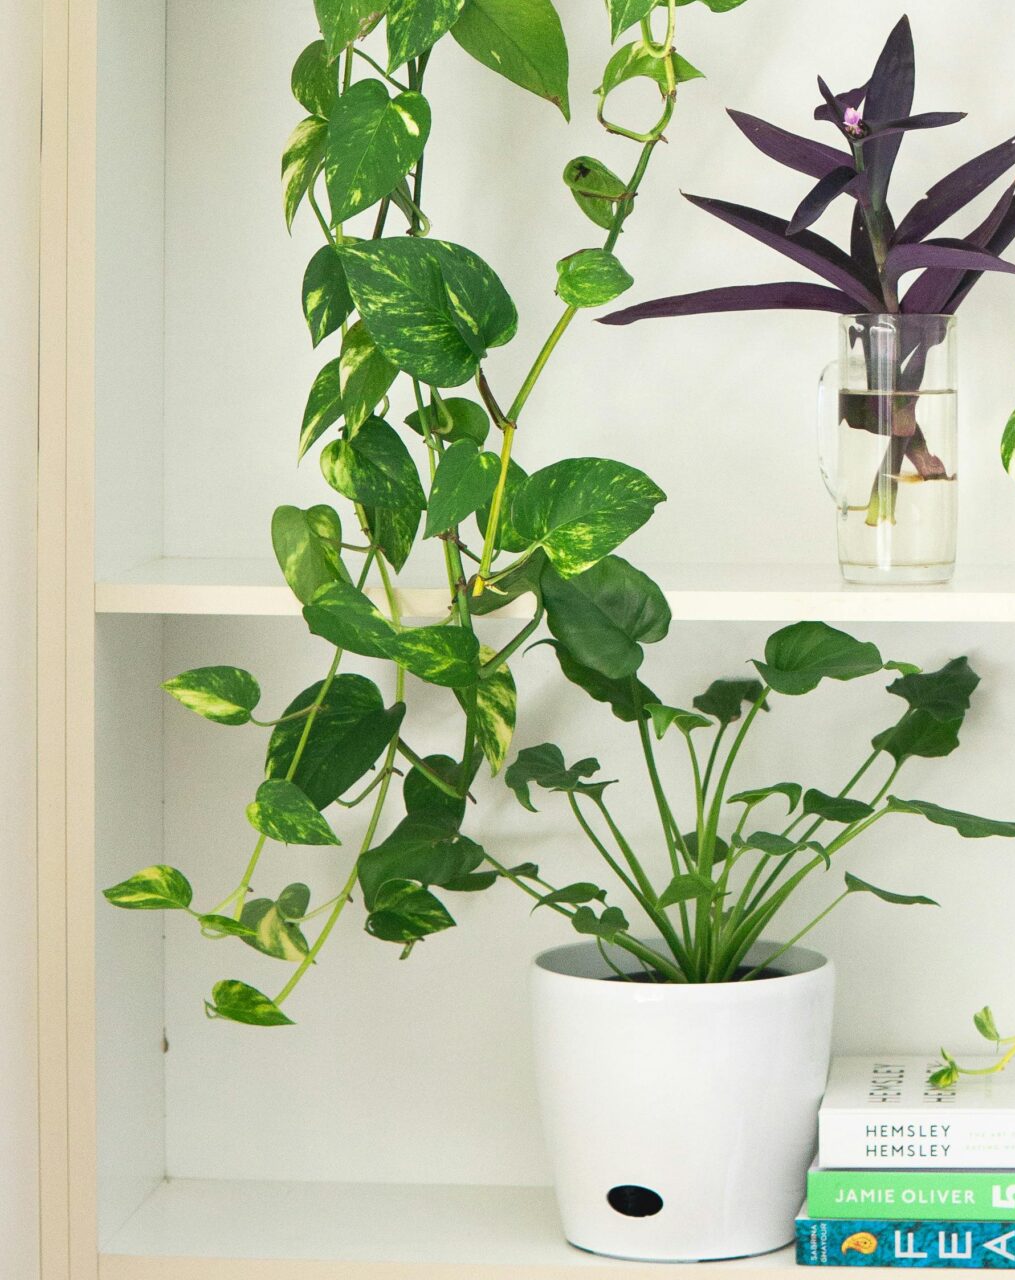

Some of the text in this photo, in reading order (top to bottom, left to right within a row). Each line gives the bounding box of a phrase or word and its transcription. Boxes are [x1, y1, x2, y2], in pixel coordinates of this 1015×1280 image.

[868, 1064, 905, 1103] HEMSLEY
[866, 1125, 951, 1138] HEMSLEY
[866, 1144, 951, 1157] HEMSLEY
[835, 1189, 894, 1203] JAMIE
[902, 1189, 976, 1204] OLIVER
[820, 1223, 828, 1263] GHAYOUR
